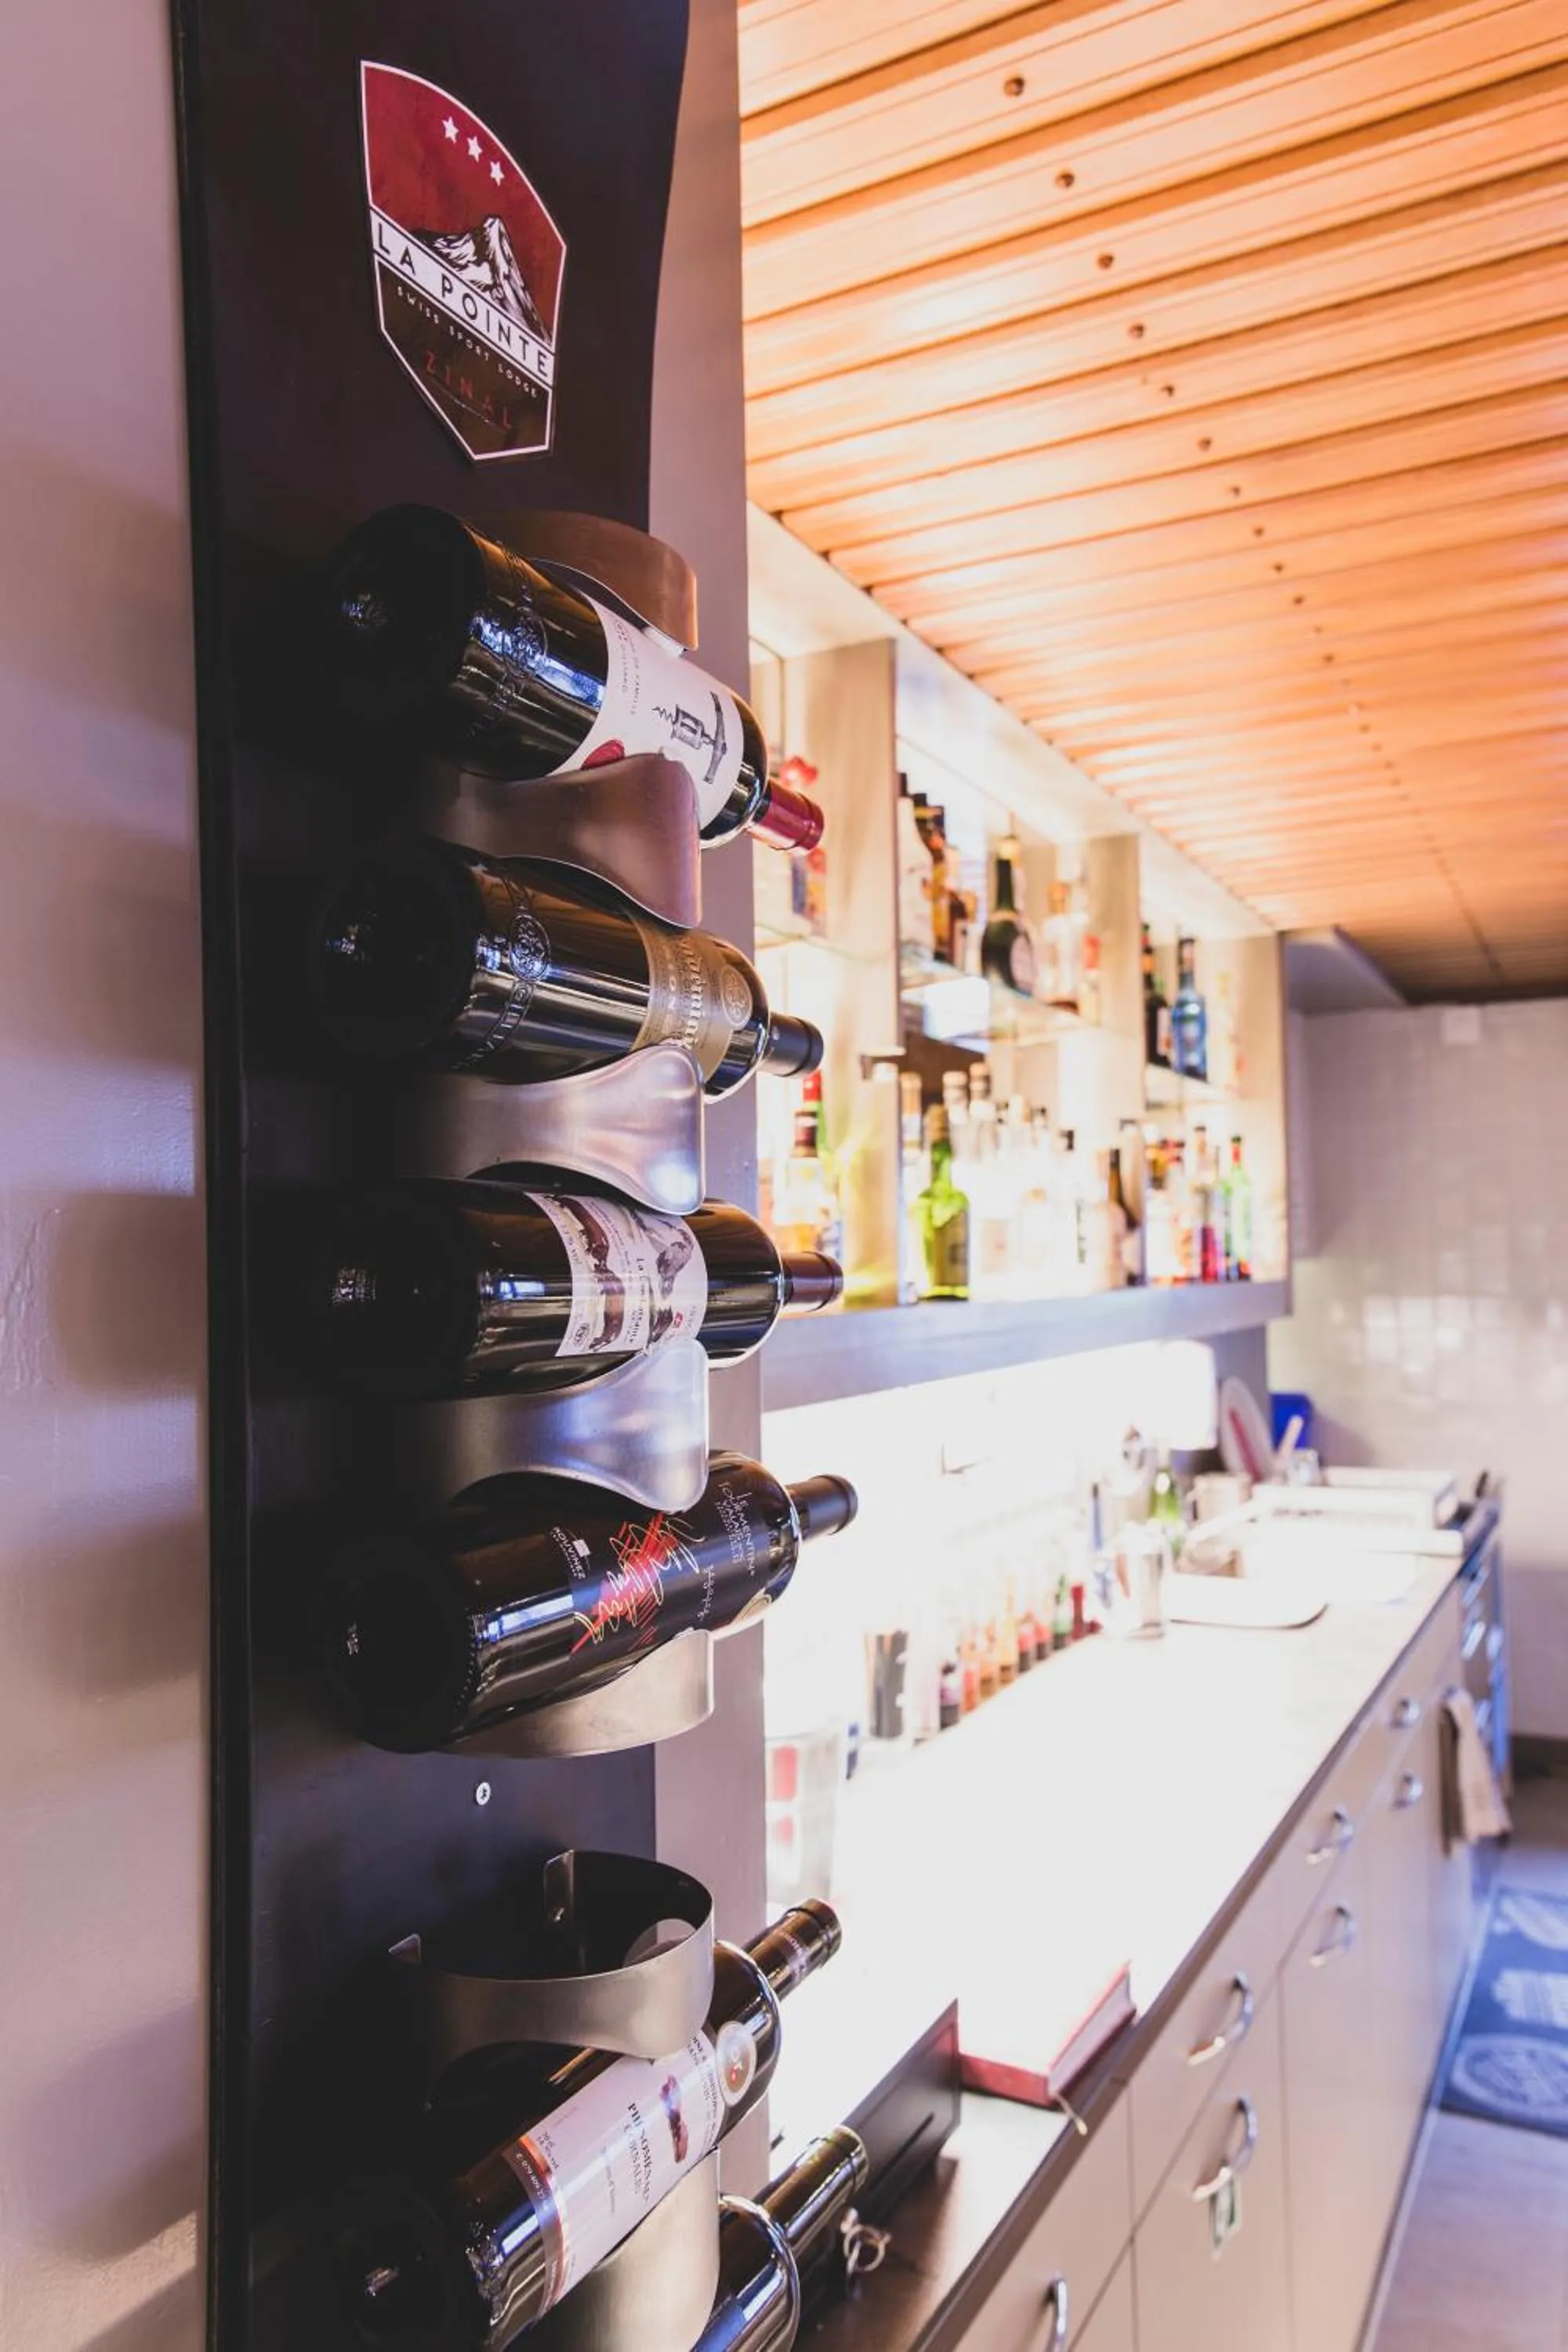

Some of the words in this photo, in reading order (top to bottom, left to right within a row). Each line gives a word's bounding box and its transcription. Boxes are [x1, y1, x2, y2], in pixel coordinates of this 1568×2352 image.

[376, 223, 416, 276] LA
[441, 275, 550, 379] POINTE
[397, 285, 440, 326] SWISS
[448, 325, 491, 363] SPORT
[497, 362, 538, 399] LODGE
[424, 350, 513, 430] ZINAL
[552, 1526, 586, 1580] ROUVINEZ
